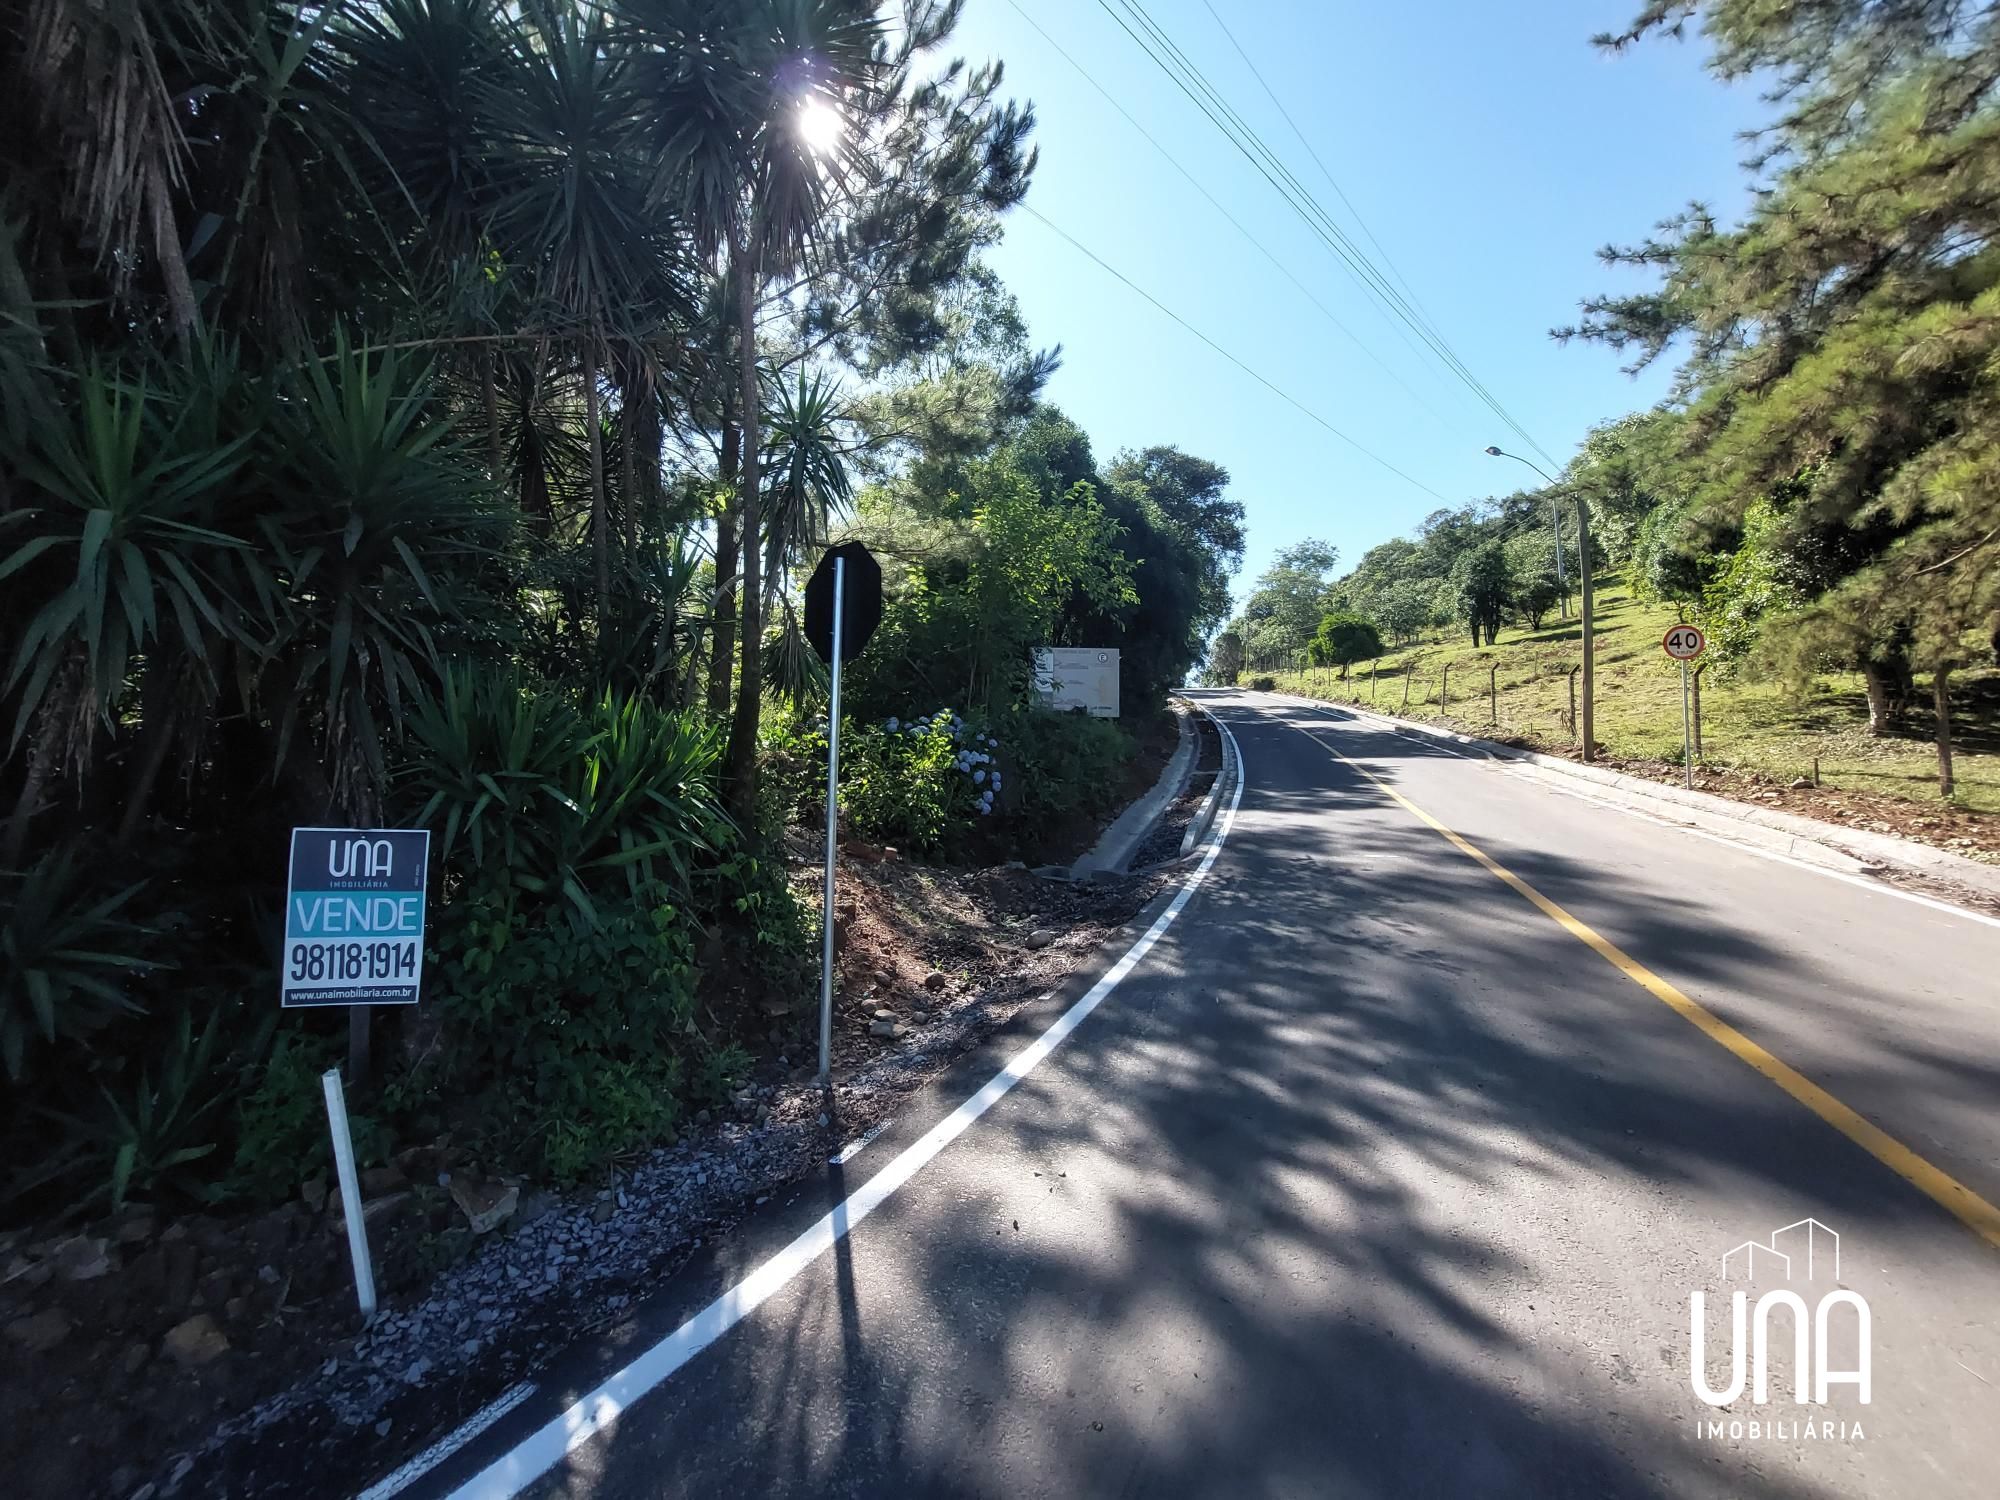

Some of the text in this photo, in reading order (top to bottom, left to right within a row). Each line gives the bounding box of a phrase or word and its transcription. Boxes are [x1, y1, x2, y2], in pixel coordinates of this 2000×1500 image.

[1669, 632, 1698, 649] 40
[328, 839, 393, 877] UNA
[330, 879, 389, 889] IMOBILIÁRIA
[295, 897, 418, 932] VENDE
[291, 987, 413, 1001] www.unaimobiliaria.com.br
